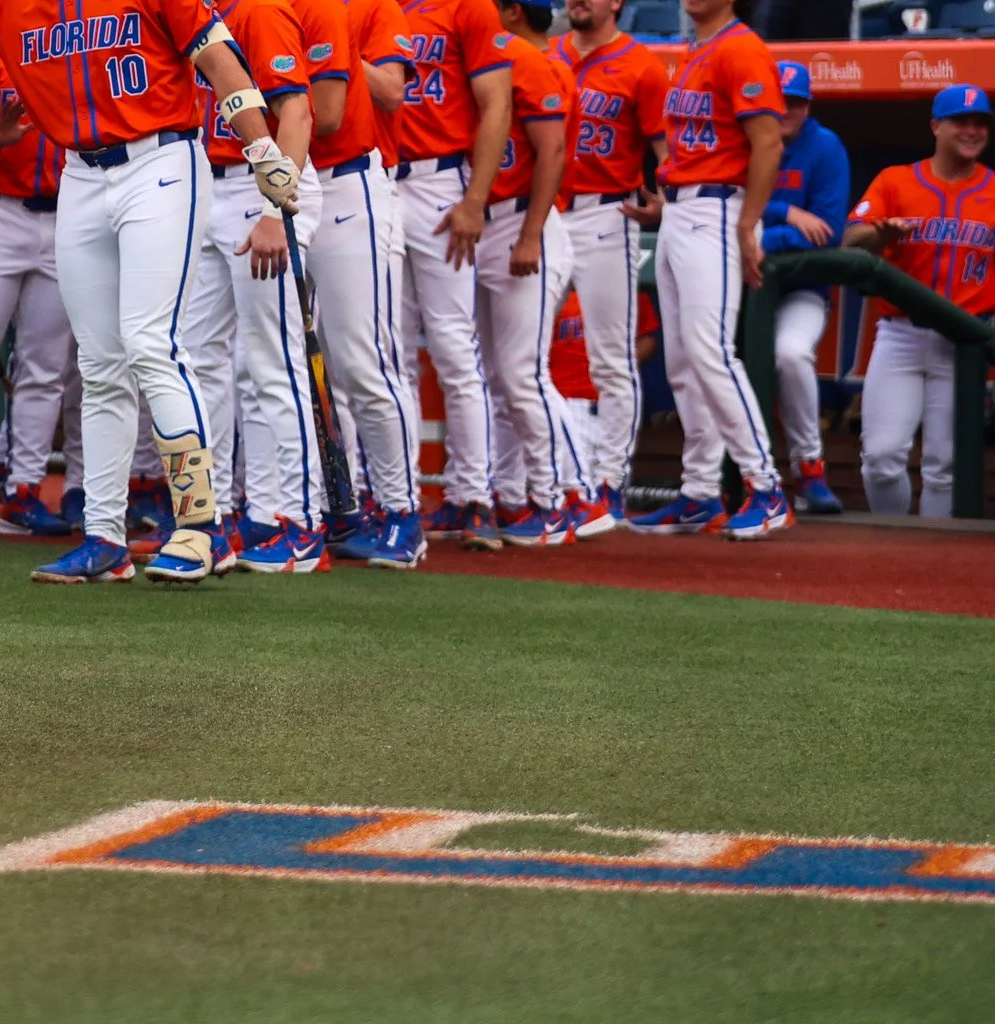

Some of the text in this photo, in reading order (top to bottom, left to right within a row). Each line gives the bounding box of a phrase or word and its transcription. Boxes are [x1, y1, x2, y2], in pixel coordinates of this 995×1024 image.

[19, 12, 141, 66] FLORIDA
[106, 53, 149, 99] 10
[225, 95, 243, 113] 10
[663, 87, 712, 117] RIDA
[577, 120, 617, 156] 23
[678, 118, 718, 152] 44
[962, 251, 988, 285] 14
